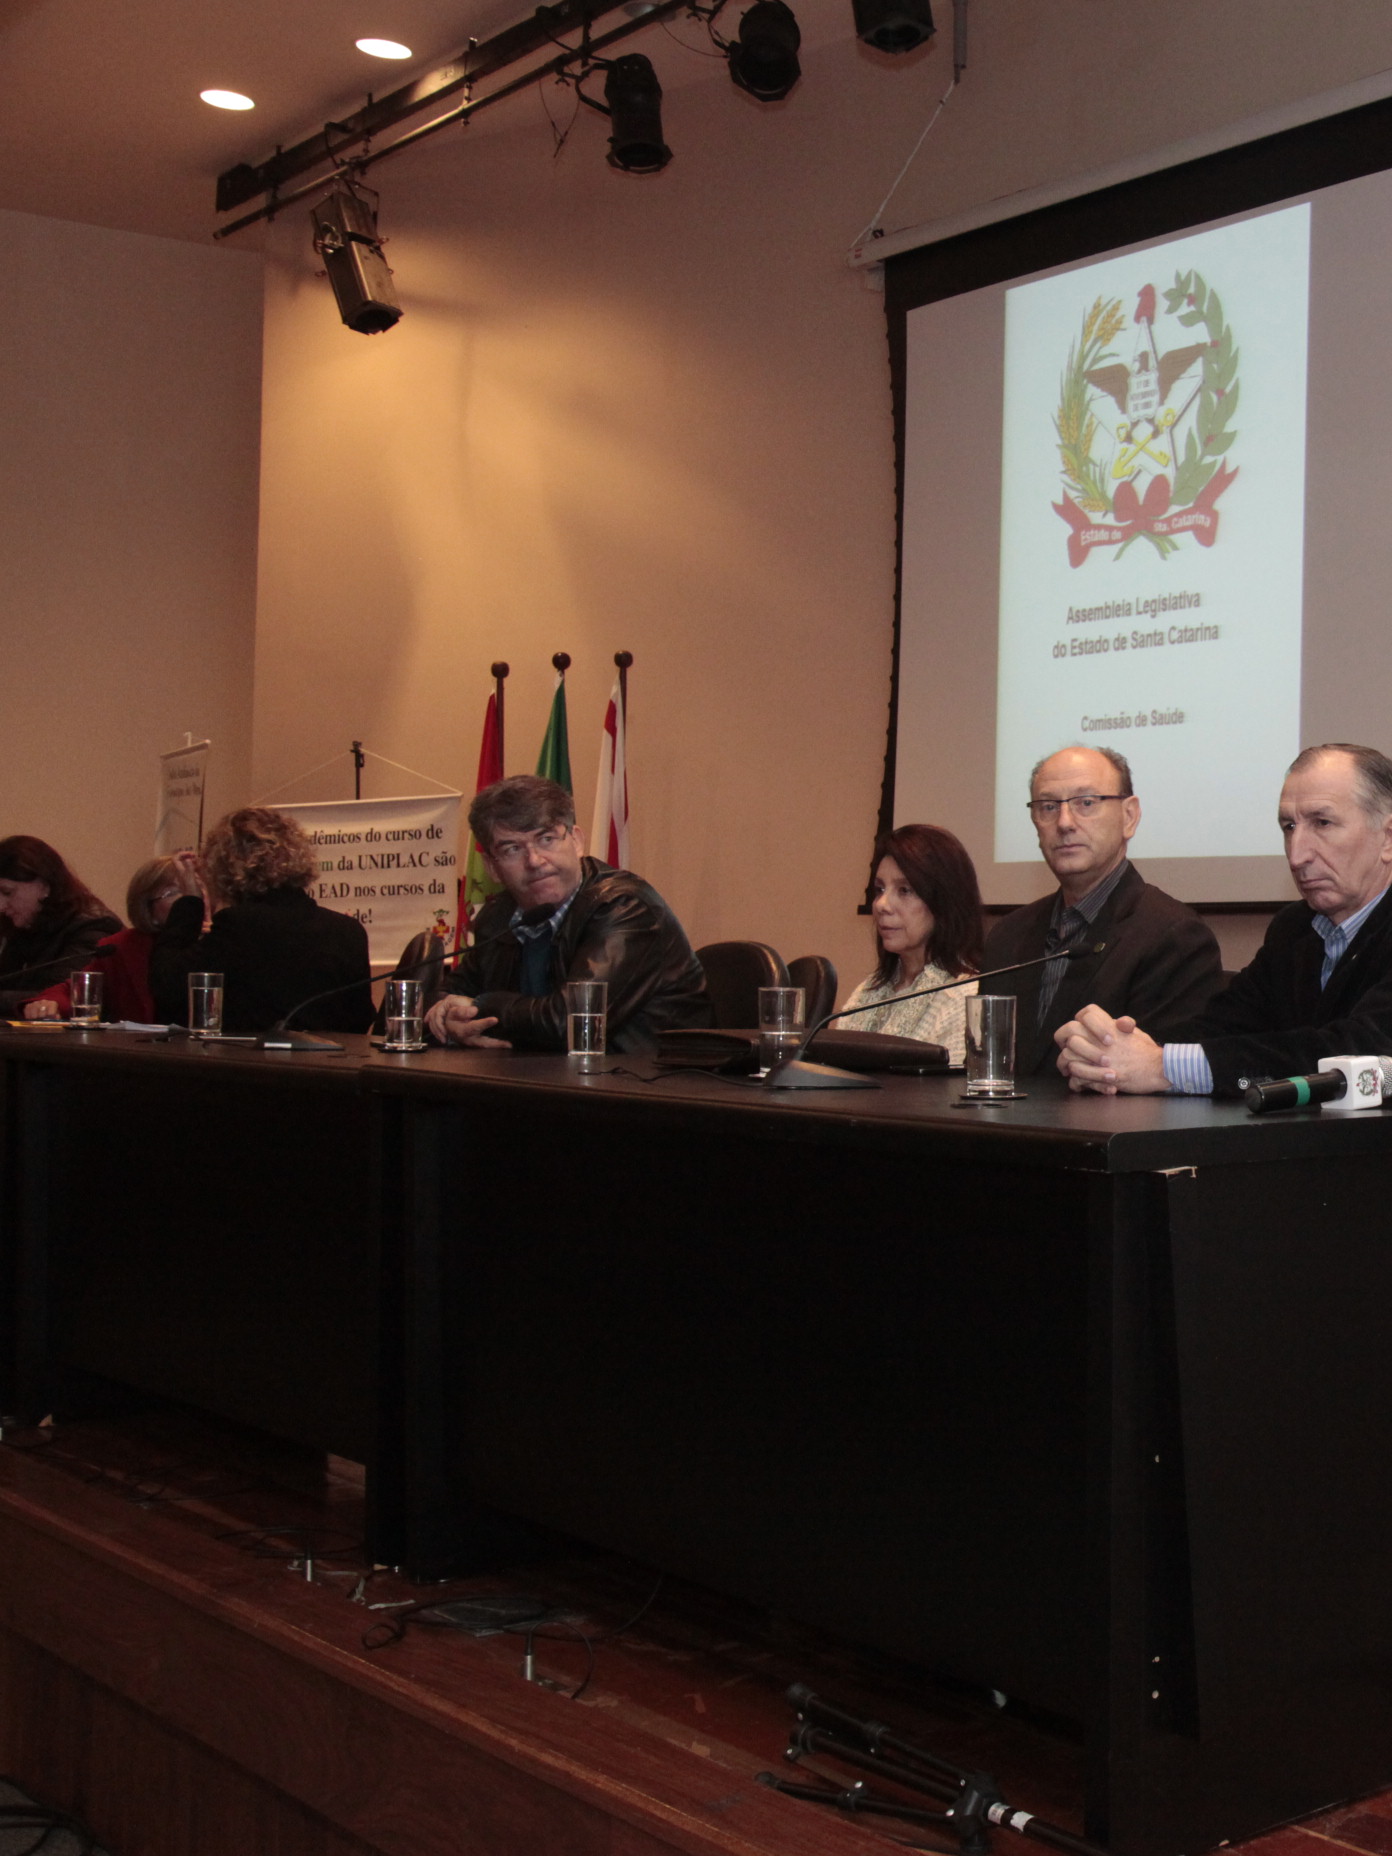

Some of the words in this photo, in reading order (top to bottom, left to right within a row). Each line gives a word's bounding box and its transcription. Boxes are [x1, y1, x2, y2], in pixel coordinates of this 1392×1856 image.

[1171, 512, 1212, 528] Catarina
[1080, 530, 1109, 546] Estado
[1111, 530, 1122, 541] de
[1066, 599, 1132, 625] Assembleia
[1135, 590, 1202, 619] Legislativa
[1052, 640, 1067, 659] do
[1070, 635, 1110, 657] Estado
[1113, 633, 1128, 652] de
[1131, 629, 1165, 650] Santa
[1168, 622, 1220, 645] Catarina
[1081, 711, 1132, 732] Comissão
[1135, 711, 1148, 728] de
[1151, 707, 1185, 726] Saúde
[365, 828, 382, 843] do
[385, 829, 422, 842] curso
[425, 824, 443, 840] de
[337, 855, 354, 871] da
[358, 851, 430, 871] UNIPLAC
[433, 851, 456, 867] são
[319, 882, 350, 899] EAD
[354, 884, 377, 897] nos
[380, 883, 424, 897] cursos
[428, 879, 446, 895] da
